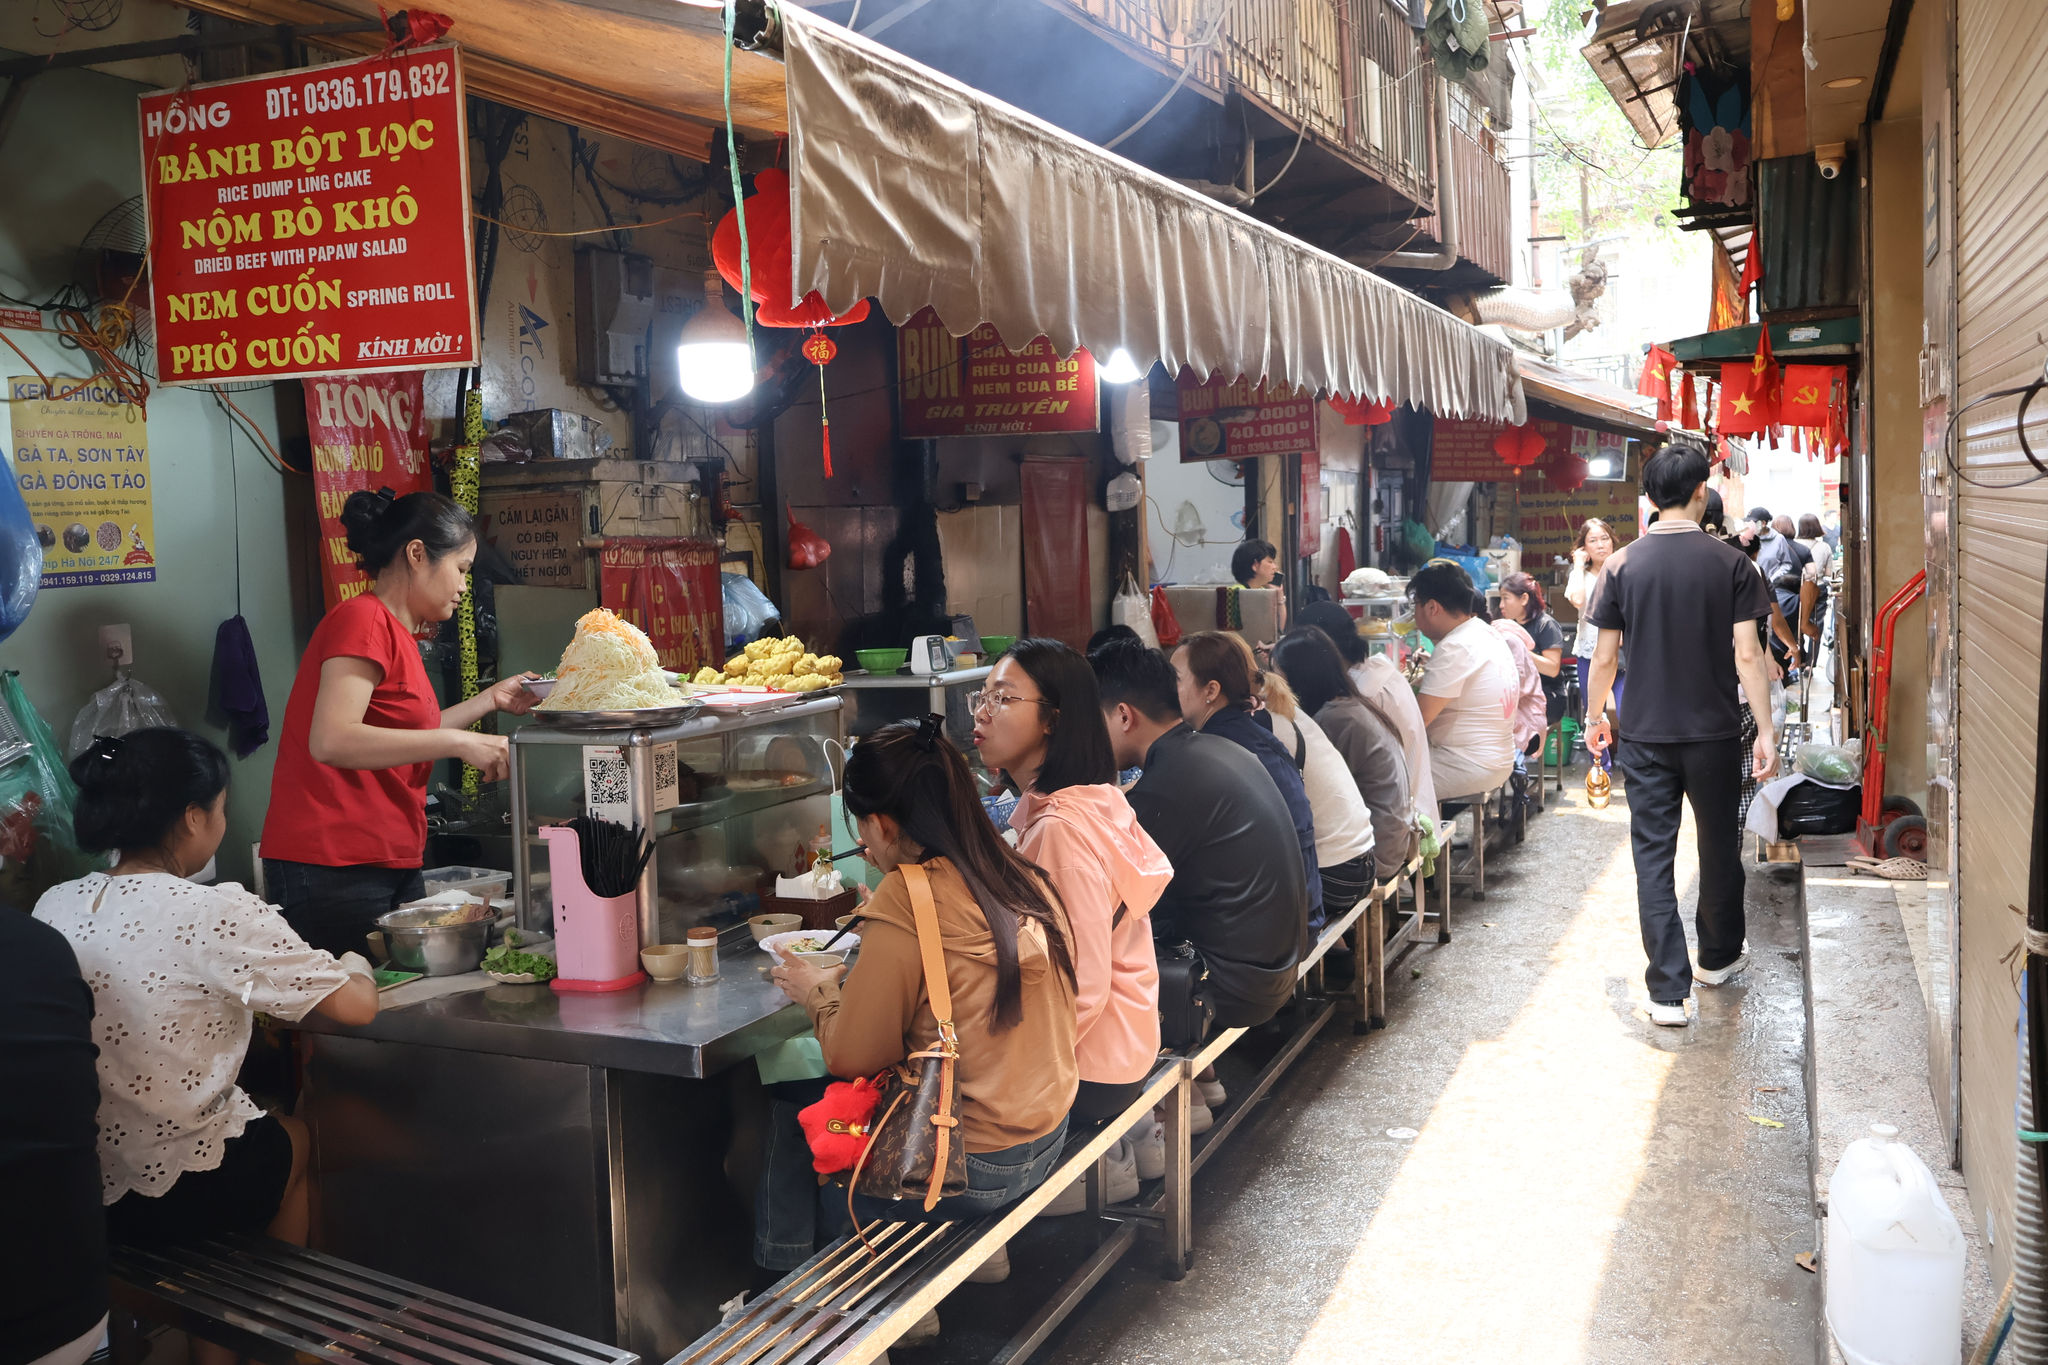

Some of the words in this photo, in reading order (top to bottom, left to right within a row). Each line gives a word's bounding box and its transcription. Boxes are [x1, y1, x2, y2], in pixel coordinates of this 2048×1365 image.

[266, 85, 299, 120] ĐT:
[304, 61, 450, 115] 0336.179.832
[147, 98, 231, 137] HỒNG
[158, 143, 262, 185] BÁNH
[270, 125, 347, 173] BỘT
[358, 118, 435, 162] LỌC
[217, 186, 249, 203] RICE
[252, 180, 294, 199] DUMP
[297, 175, 330, 193] LING
[334, 169, 372, 188] CAKE
[180, 207, 262, 253] NỘM
[272, 197, 323, 240] BÒ
[332, 184, 419, 233] KHÔ
[194, 256, 232, 275] DRIED
[235, 252, 268, 271] BEEF
[271, 249, 306, 266] WITH
[308, 243, 358, 263] PAPAW
[362, 237, 407, 257] SALAD
[167, 289, 238, 323] NEM
[246, 267, 343, 316] CUỐN
[347, 285, 409, 308] SPRING
[413, 282, 455, 301] ROLL
[171, 331, 239, 374] PHỞ
[246, 321, 341, 369] CUỐN
[357, 336, 409, 358] KÍNH
[413, 331, 452, 356] MỜI
[809, 340, 830, 360] 福
[972, 362, 1011, 377] RIÊU
[1015, 361, 1050, 375] CUA
[1055, 358, 1079, 373] BÒ
[972, 381, 1011, 396] NEM
[1016, 380, 1051, 394] CUA
[1055, 374, 1078, 391] BỂ
[925, 404, 966, 420] GIA
[964, 420, 997, 433] KÍNH
[17, 443, 42, 463] GÀ
[46, 447, 73, 465] TA,
[77, 446, 112, 463] SƠN
[115, 445, 145, 463] TÂY
[20, 470, 48, 490] GÀ
[52, 470, 106, 490] ĐÔNG
[110, 468, 146, 489] TẢO
[499, 504, 522, 526] CẤM
[525, 507, 543, 527] LẠI
[517, 530, 532, 543] CÓ
[534, 529, 559, 545] ĐIỆN
[99, 555, 120, 567] 24/7
[511, 549, 540, 561] NGUY
